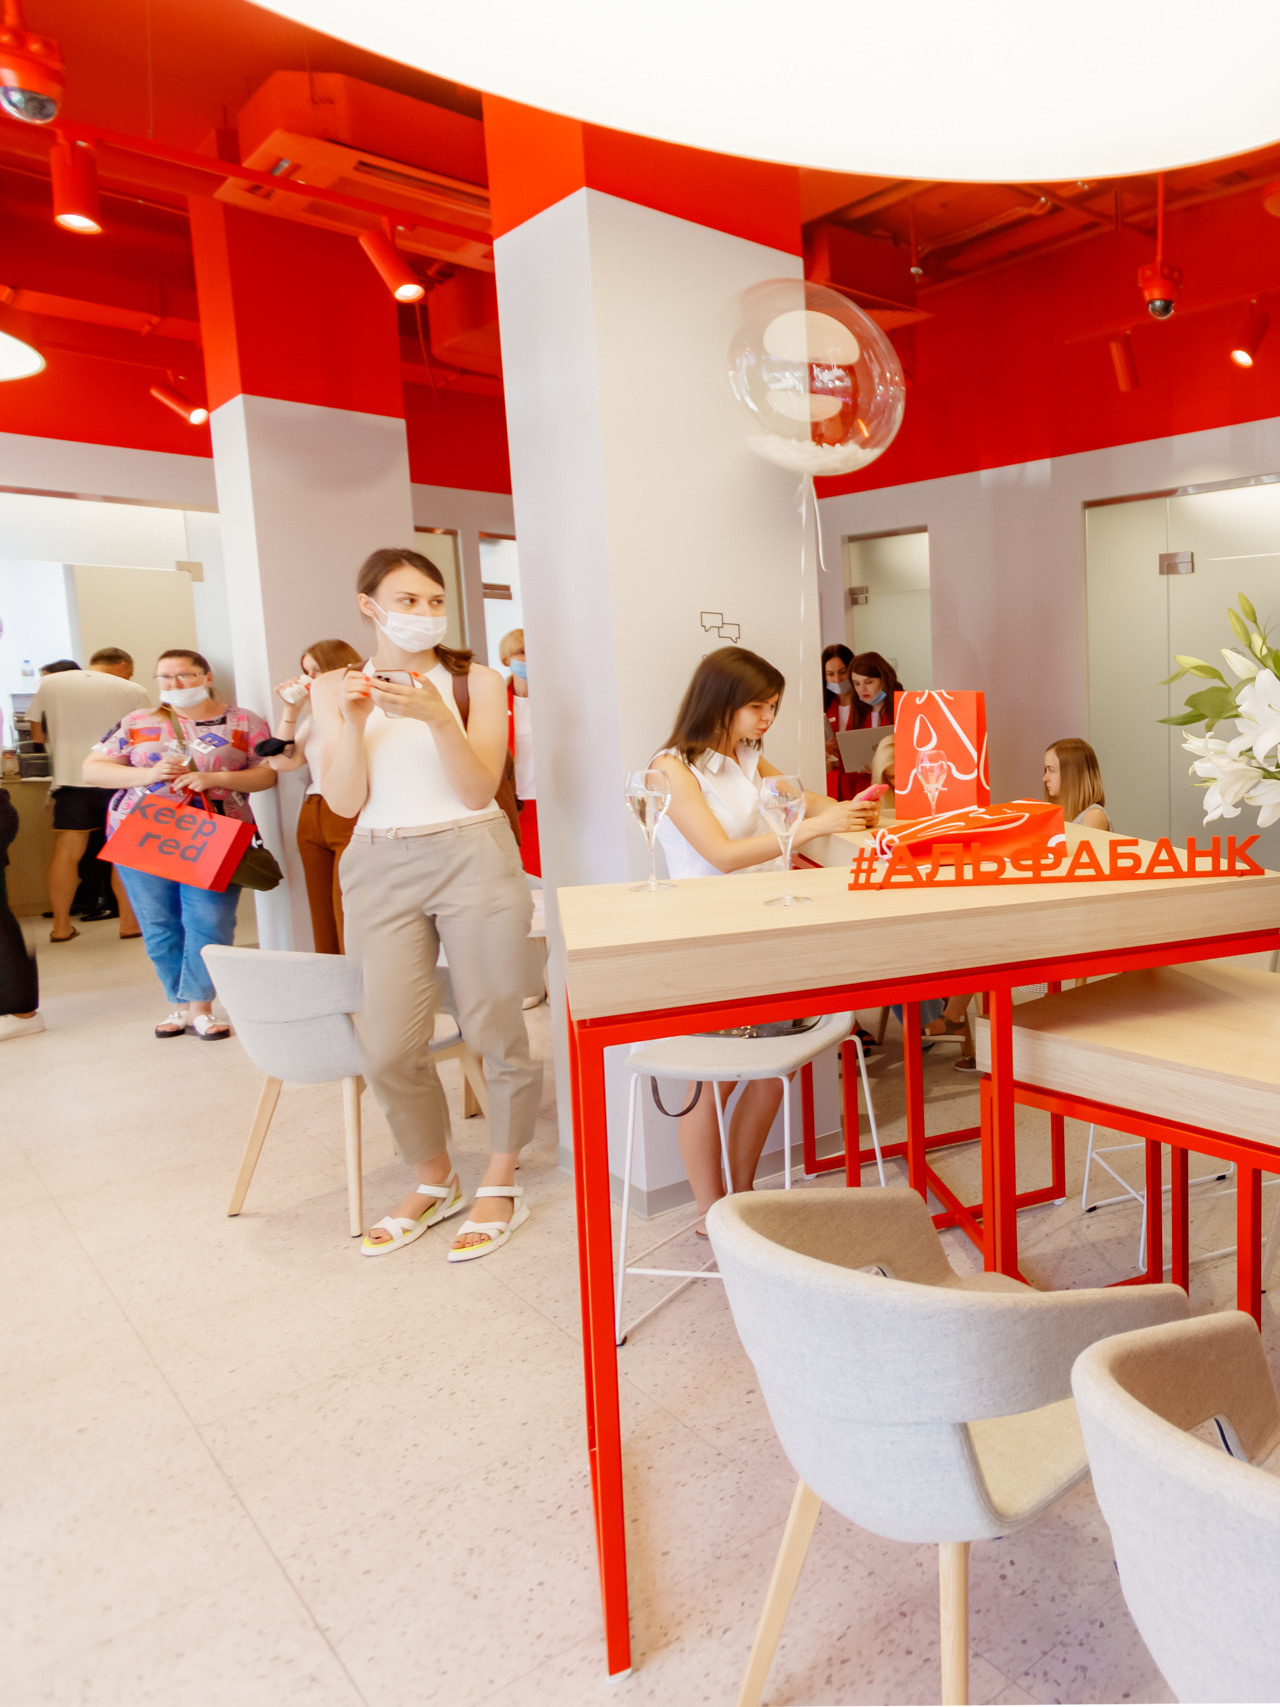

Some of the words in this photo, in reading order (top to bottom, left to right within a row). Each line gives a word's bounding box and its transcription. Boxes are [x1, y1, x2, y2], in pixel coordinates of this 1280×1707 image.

[129, 793, 218, 841] keep
[136, 830, 209, 864] red
[849, 834, 1265, 886] #АЛЬФАБАНК
